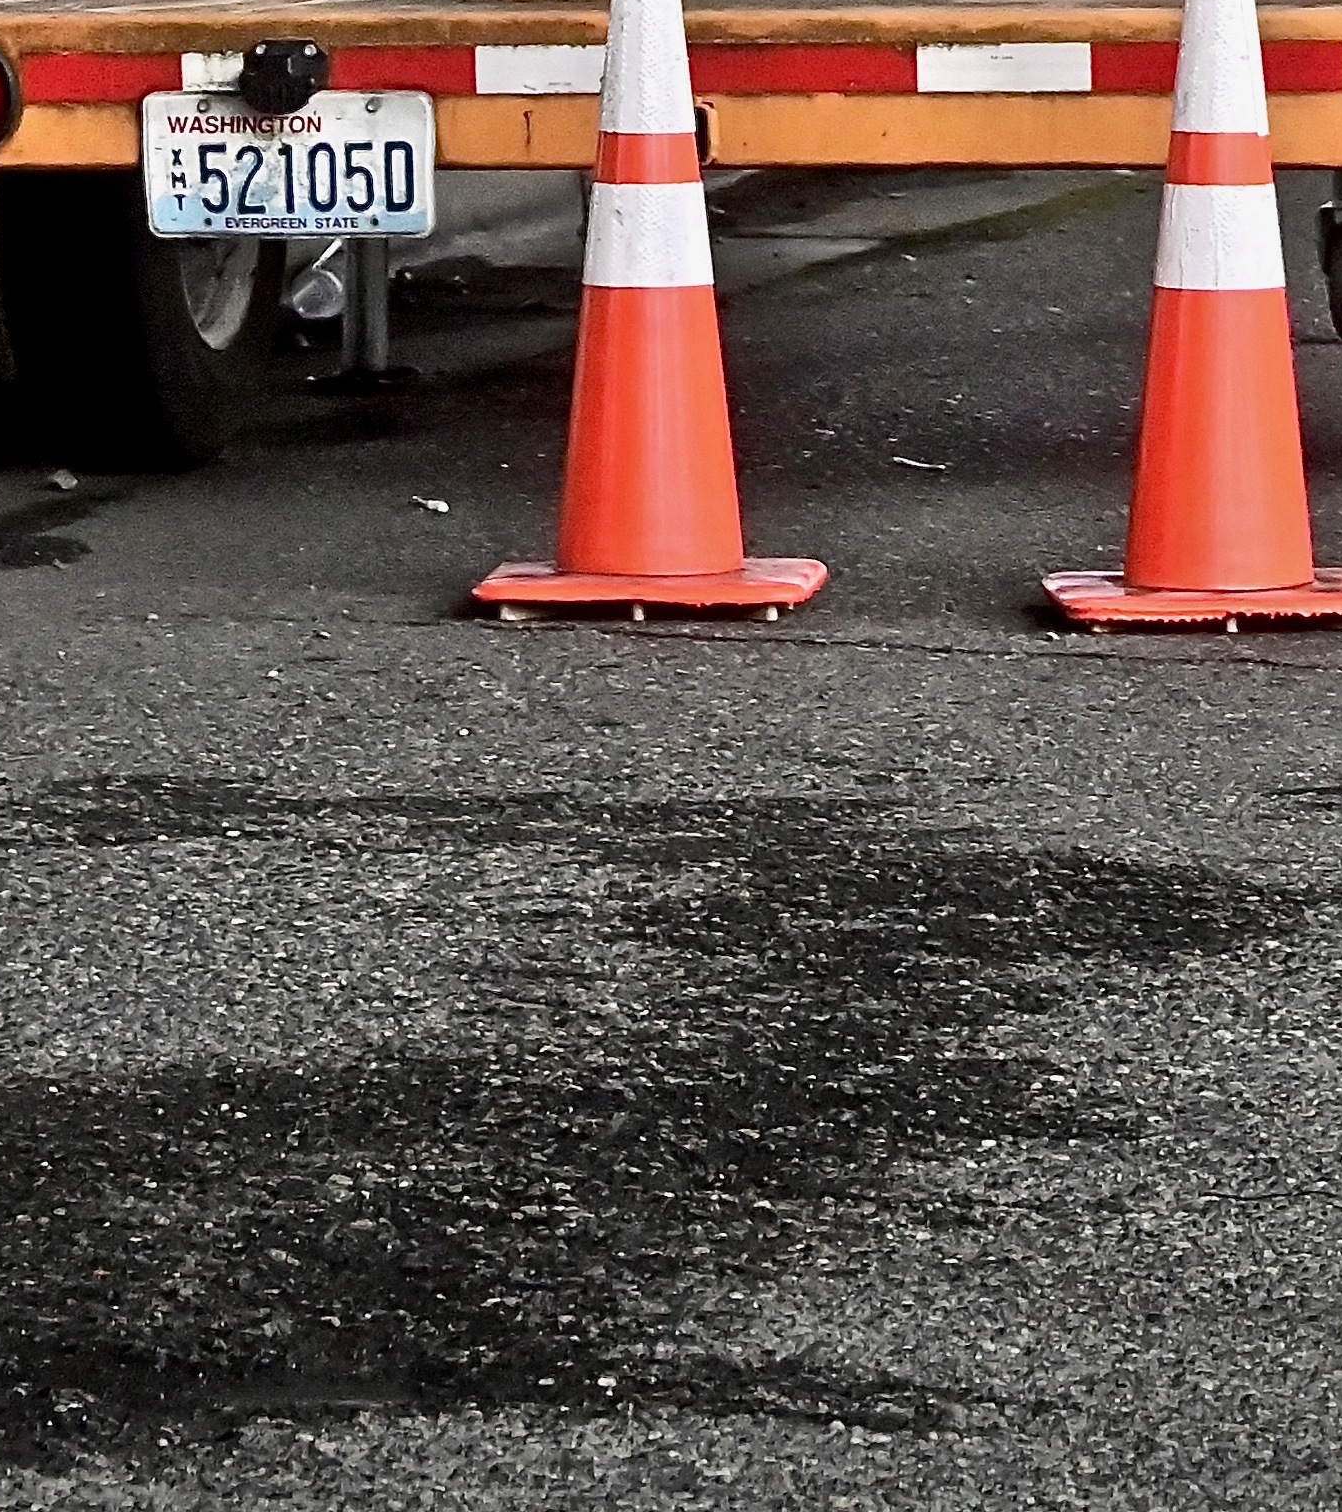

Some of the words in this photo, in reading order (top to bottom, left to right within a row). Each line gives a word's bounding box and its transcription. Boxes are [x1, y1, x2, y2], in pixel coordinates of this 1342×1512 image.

[167, 115, 322, 134] WASHINGTON
[197, 141, 415, 214] 52105D
[224, 217, 308, 229] EVERGREEN
[315, 217, 359, 229] STATE
